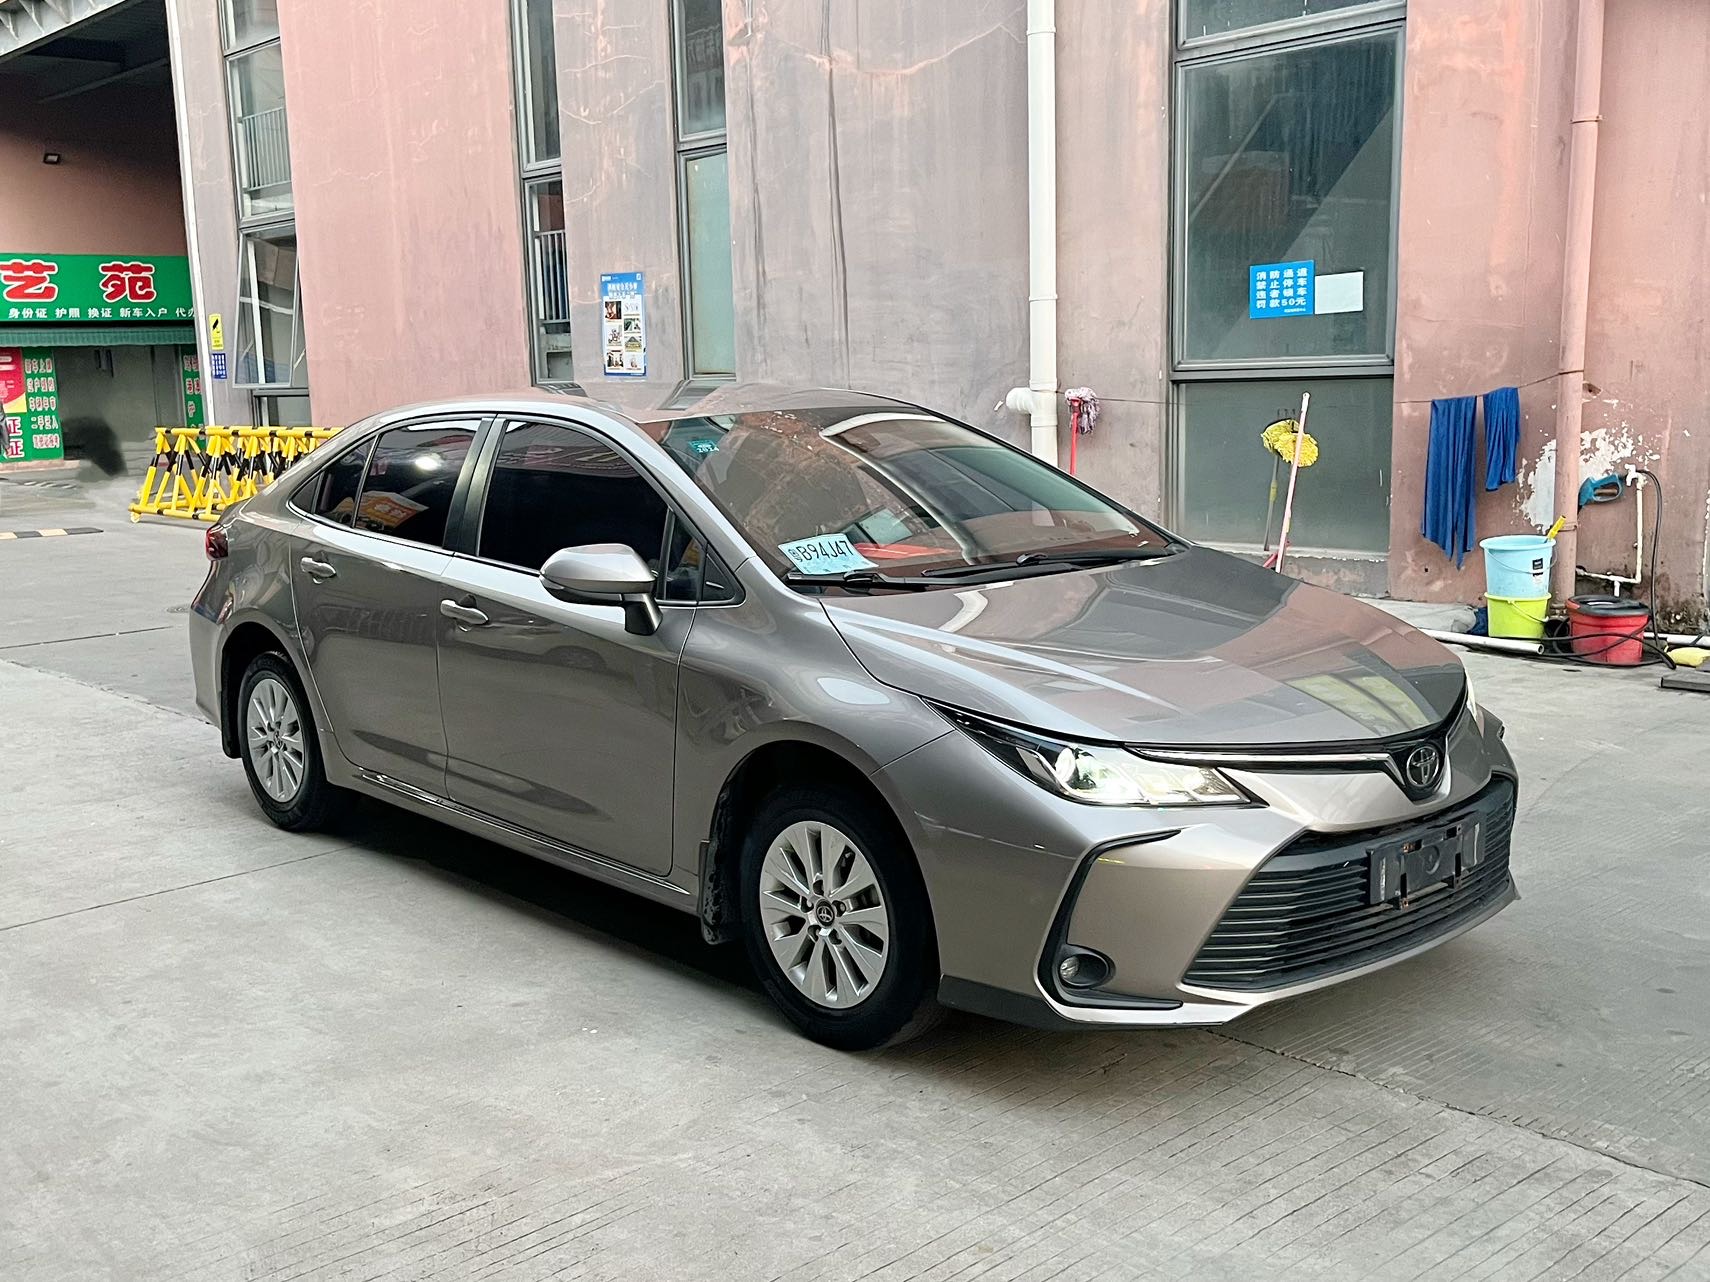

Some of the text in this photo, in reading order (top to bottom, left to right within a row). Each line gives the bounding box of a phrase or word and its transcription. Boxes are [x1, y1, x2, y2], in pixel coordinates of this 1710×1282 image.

[1256, 268, 1308, 280] 消防通道
[1256, 278, 1308, 290] 禁止停车
[1256, 297, 1307, 309] 罚款50元
[8, 307, 48, 319] 身份证
[55, 307, 81, 318] 护照
[88, 307, 113, 318] 换证
[119, 307, 168, 318] 新车入户
